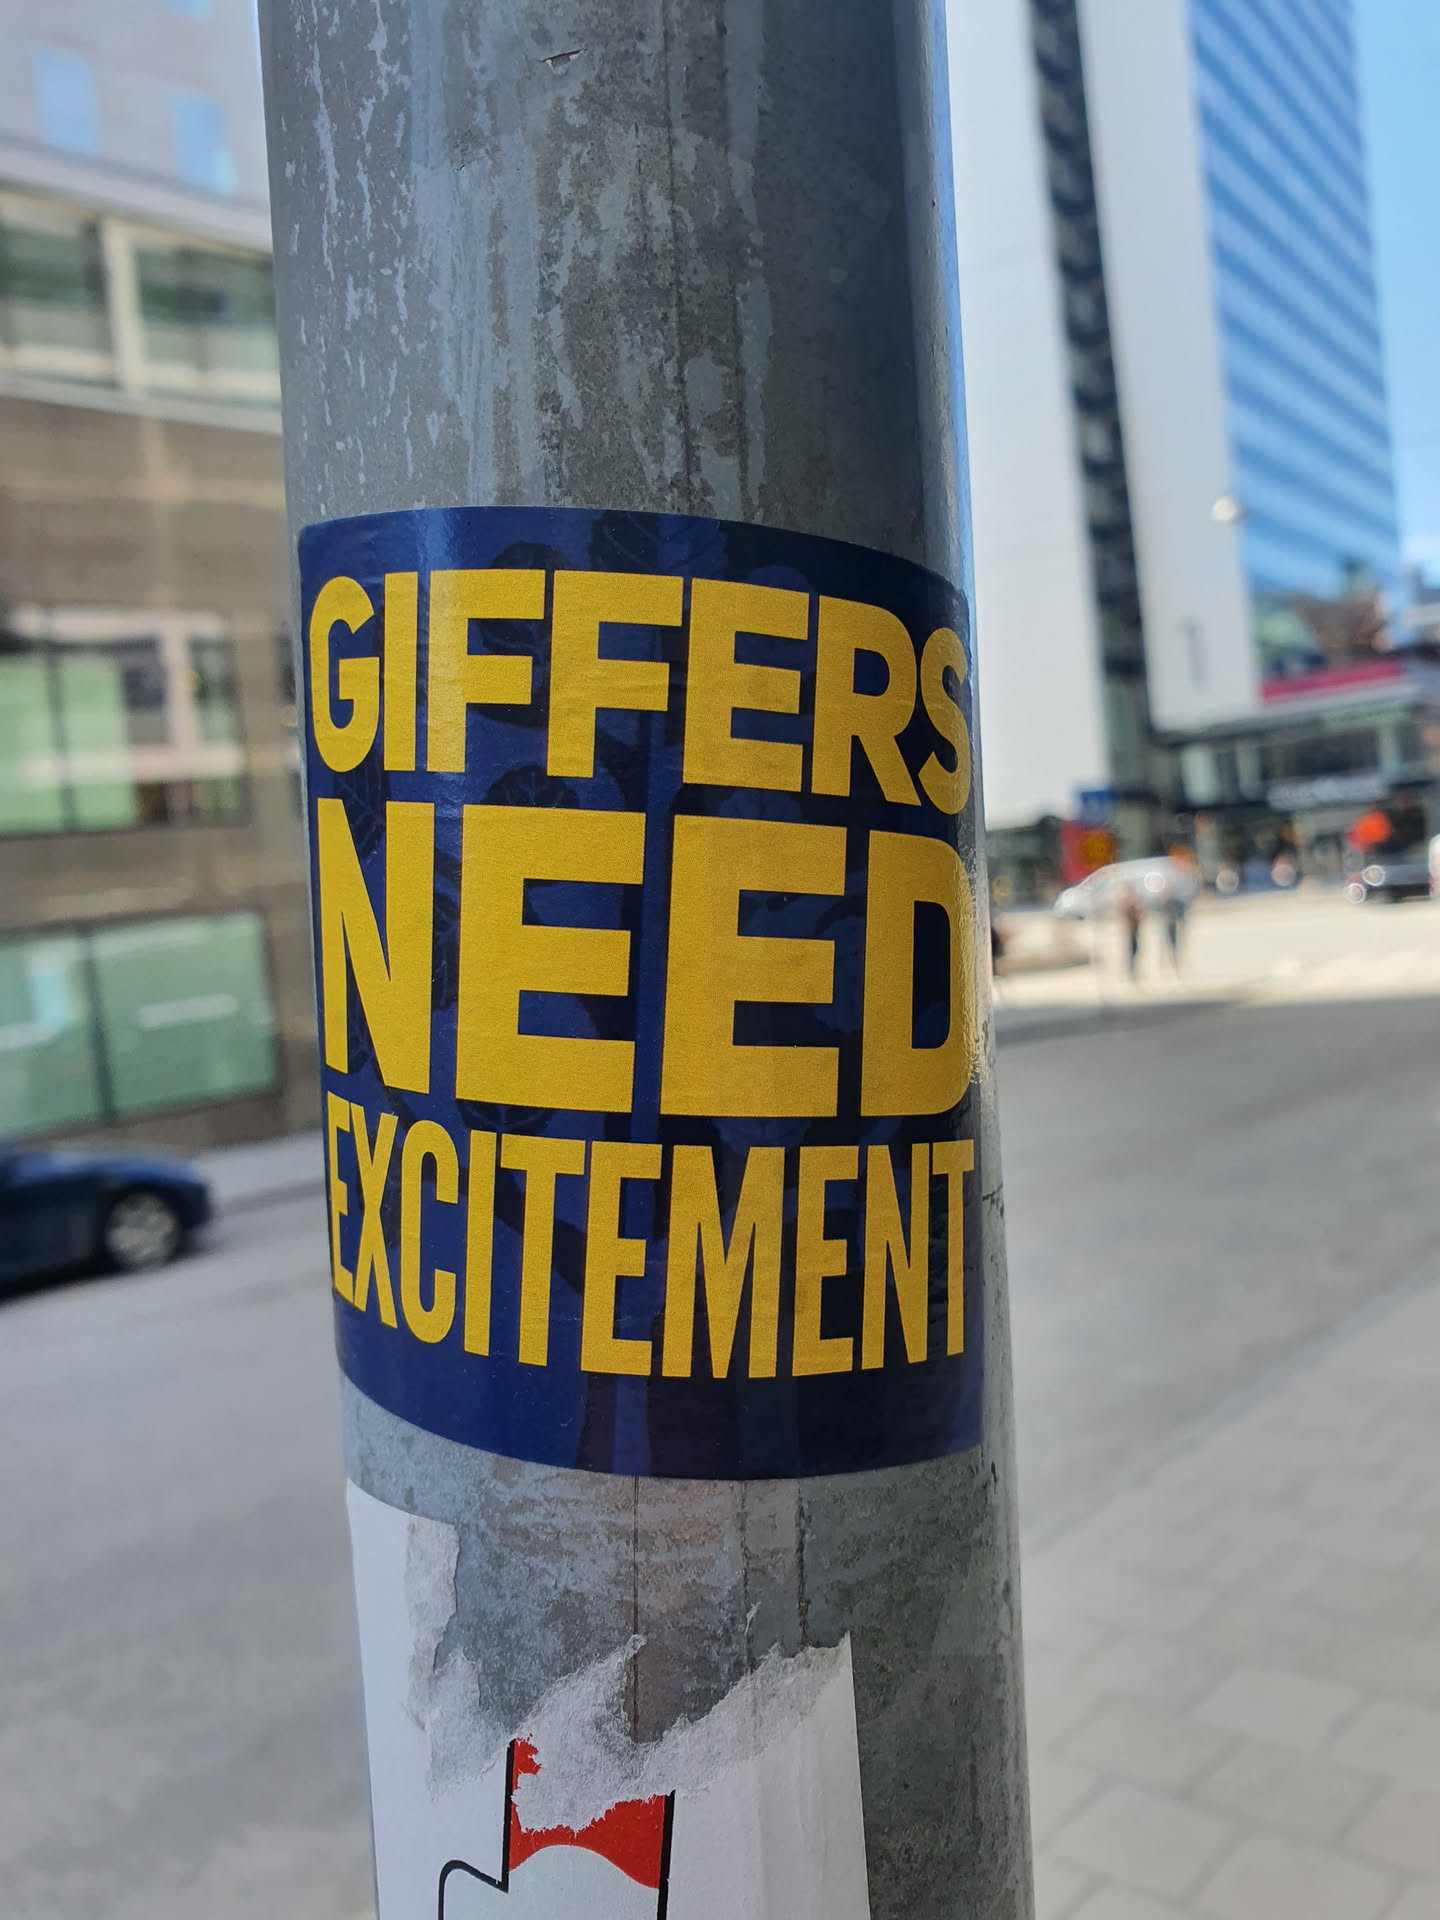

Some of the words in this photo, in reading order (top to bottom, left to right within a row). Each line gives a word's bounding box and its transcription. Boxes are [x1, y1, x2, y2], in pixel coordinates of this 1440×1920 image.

[309, 569, 971, 815] GIFFERS
[317, 798, 980, 1117] NEED
[327, 1092, 976, 1379] EXCITEMENT
